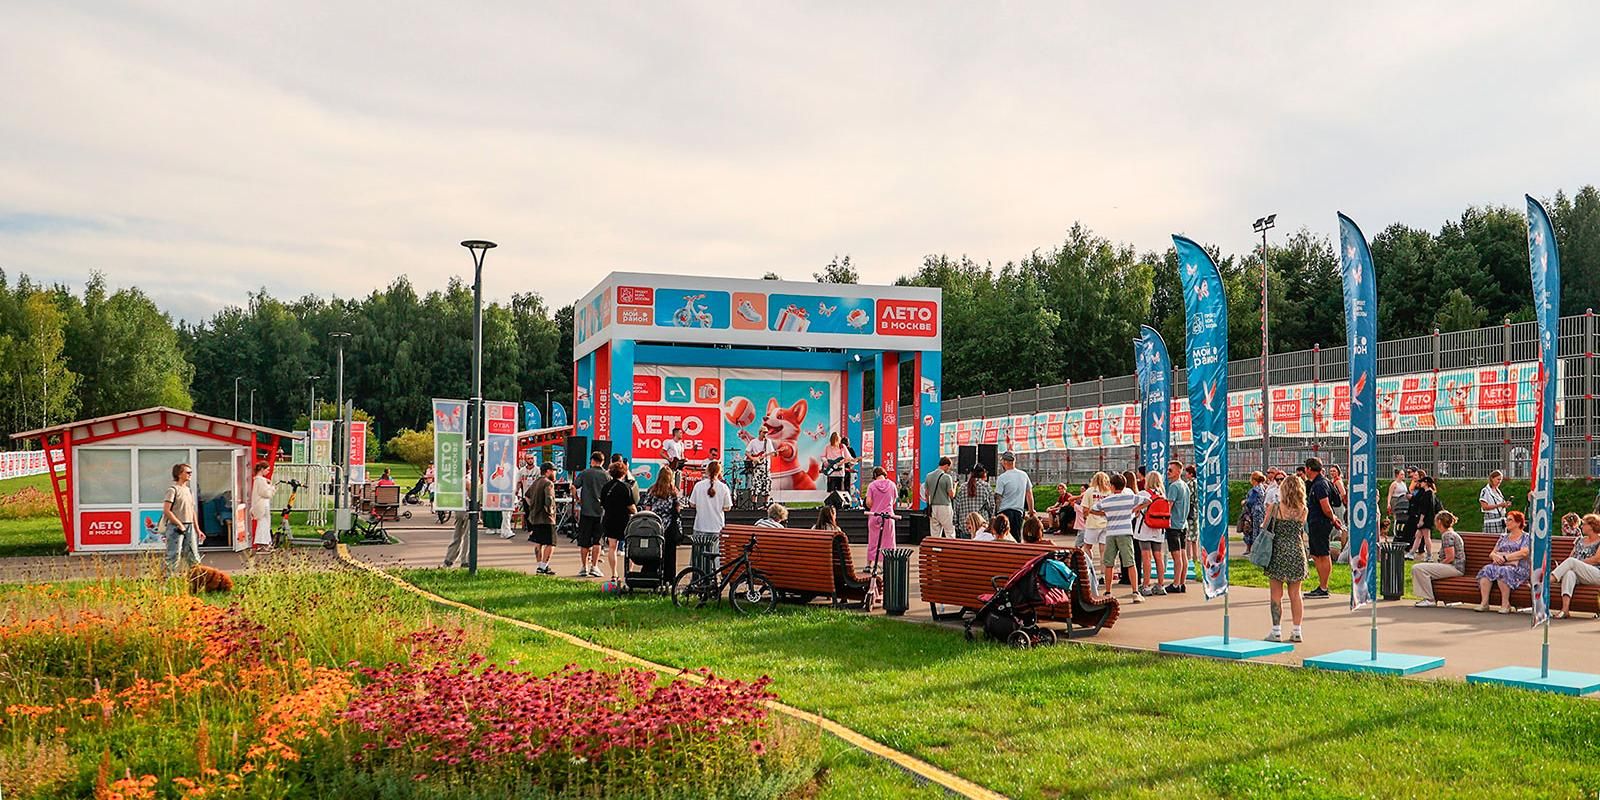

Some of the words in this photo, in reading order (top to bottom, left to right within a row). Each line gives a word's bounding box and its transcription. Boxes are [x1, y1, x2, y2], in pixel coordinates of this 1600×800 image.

[881, 306, 932, 321] ЛЕТО
[881, 321, 888, 329] В
[891, 322, 932, 331] МОСКВЕ
[1483, 387, 1512, 399] ЛЕТО
[1339, 401, 1349, 409] ЛЕ
[1406, 394, 1432, 405] ЛЕТО
[599, 388, 608, 432] МОСКВЕ
[1228, 409, 1241, 418] ЕТО
[1275, 404, 1296, 413] ЛЕТО
[637, 438, 703, 450] МОВЕ
[441, 442, 451, 484] ЛЕТО
[1207, 430, 1223, 526] ЛЕТО
[1353, 425, 1368, 529] ЛЕТО
[89, 521, 123, 530] ЛЕТО
